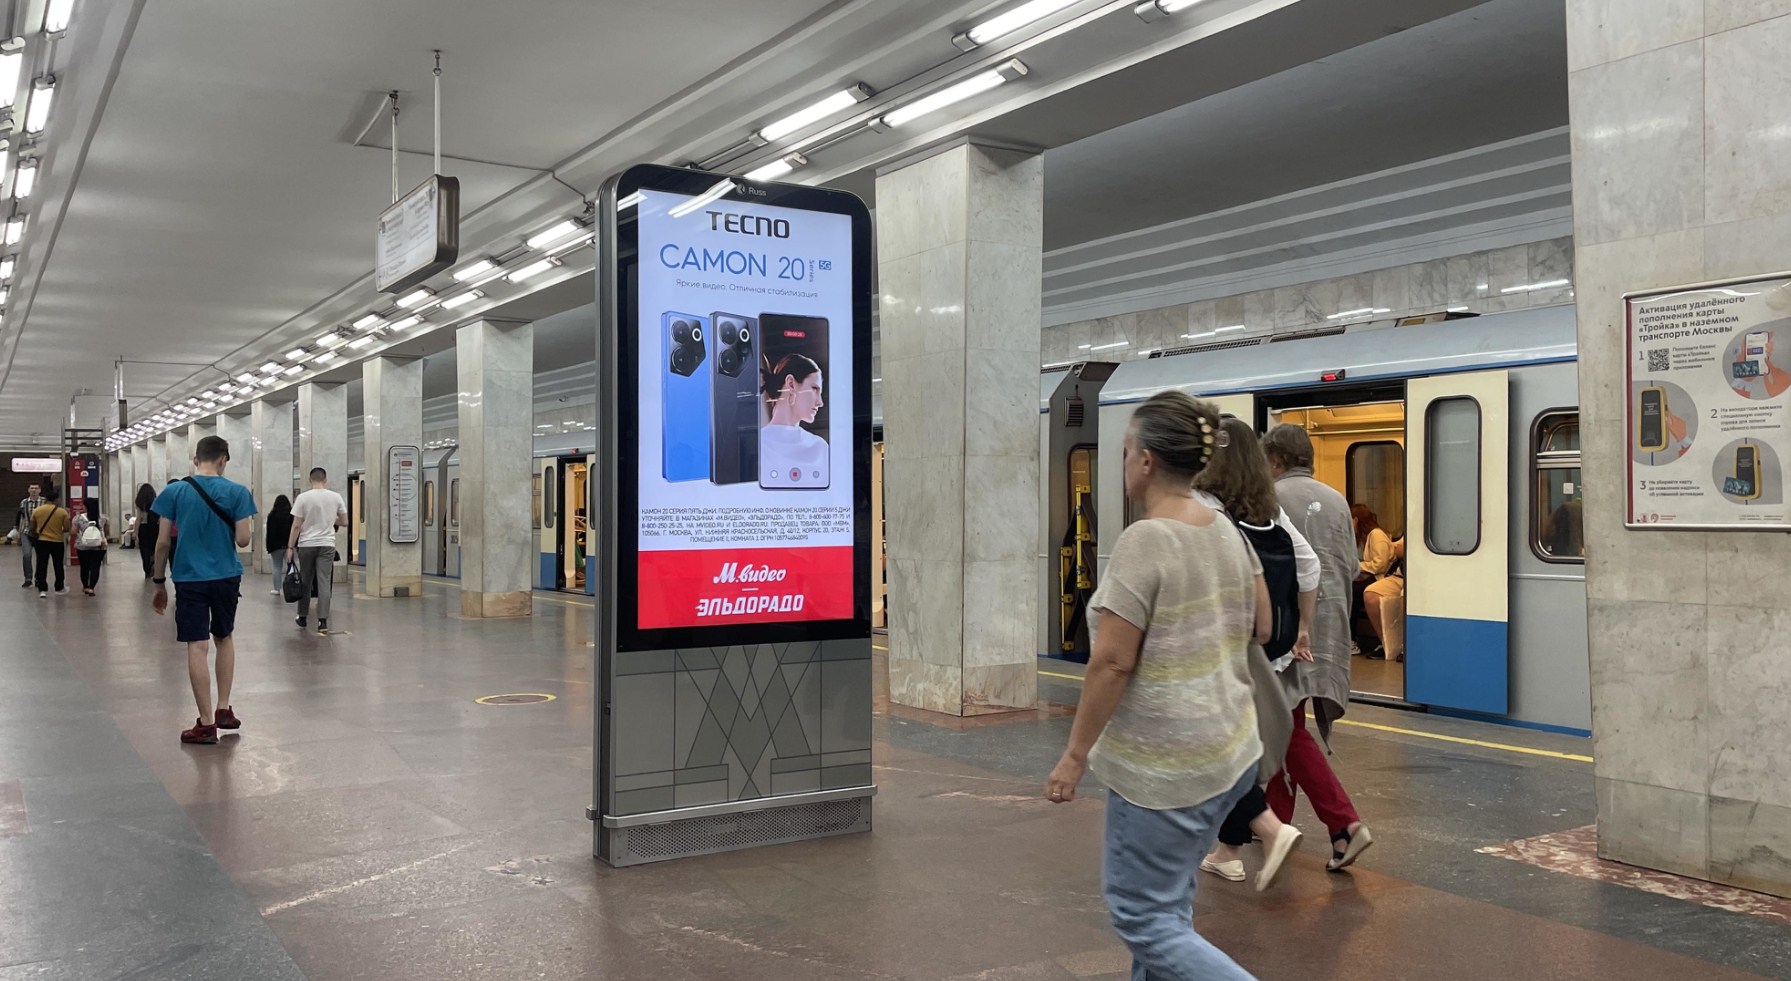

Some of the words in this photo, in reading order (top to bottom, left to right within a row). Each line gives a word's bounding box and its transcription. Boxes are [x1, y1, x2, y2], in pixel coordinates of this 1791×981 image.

[748, 187, 766, 196] Russ
[706, 210, 790, 239] TECNO
[660, 244, 767, 277] CAMON
[778, 256, 804, 281] 20
[819, 260, 832, 270] 5G
[676, 279, 700, 289] Яркие
[729, 284, 766, 294] Отличная
[768, 287, 818, 298] стабилизация
[1638, 303, 1687, 315] Активация
[1689, 296, 1746, 310] удалённого
[1638, 312, 1693, 324] пополнения
[1696, 308, 1724, 319] карты
[1638, 322, 1679, 334] «Тройка»
[1690, 316, 1739, 327] наземном
[1638, 331, 1690, 343] транспорте
[1692, 325, 1732, 336] Москвы
[1638, 351, 1644, 360] 1
[1710, 408, 1718, 419] 2
[1640, 480, 1646, 490] 3
[712, 562, 786, 584] М.видео
[696, 594, 804, 616] ЭЛЬДОРАДО
